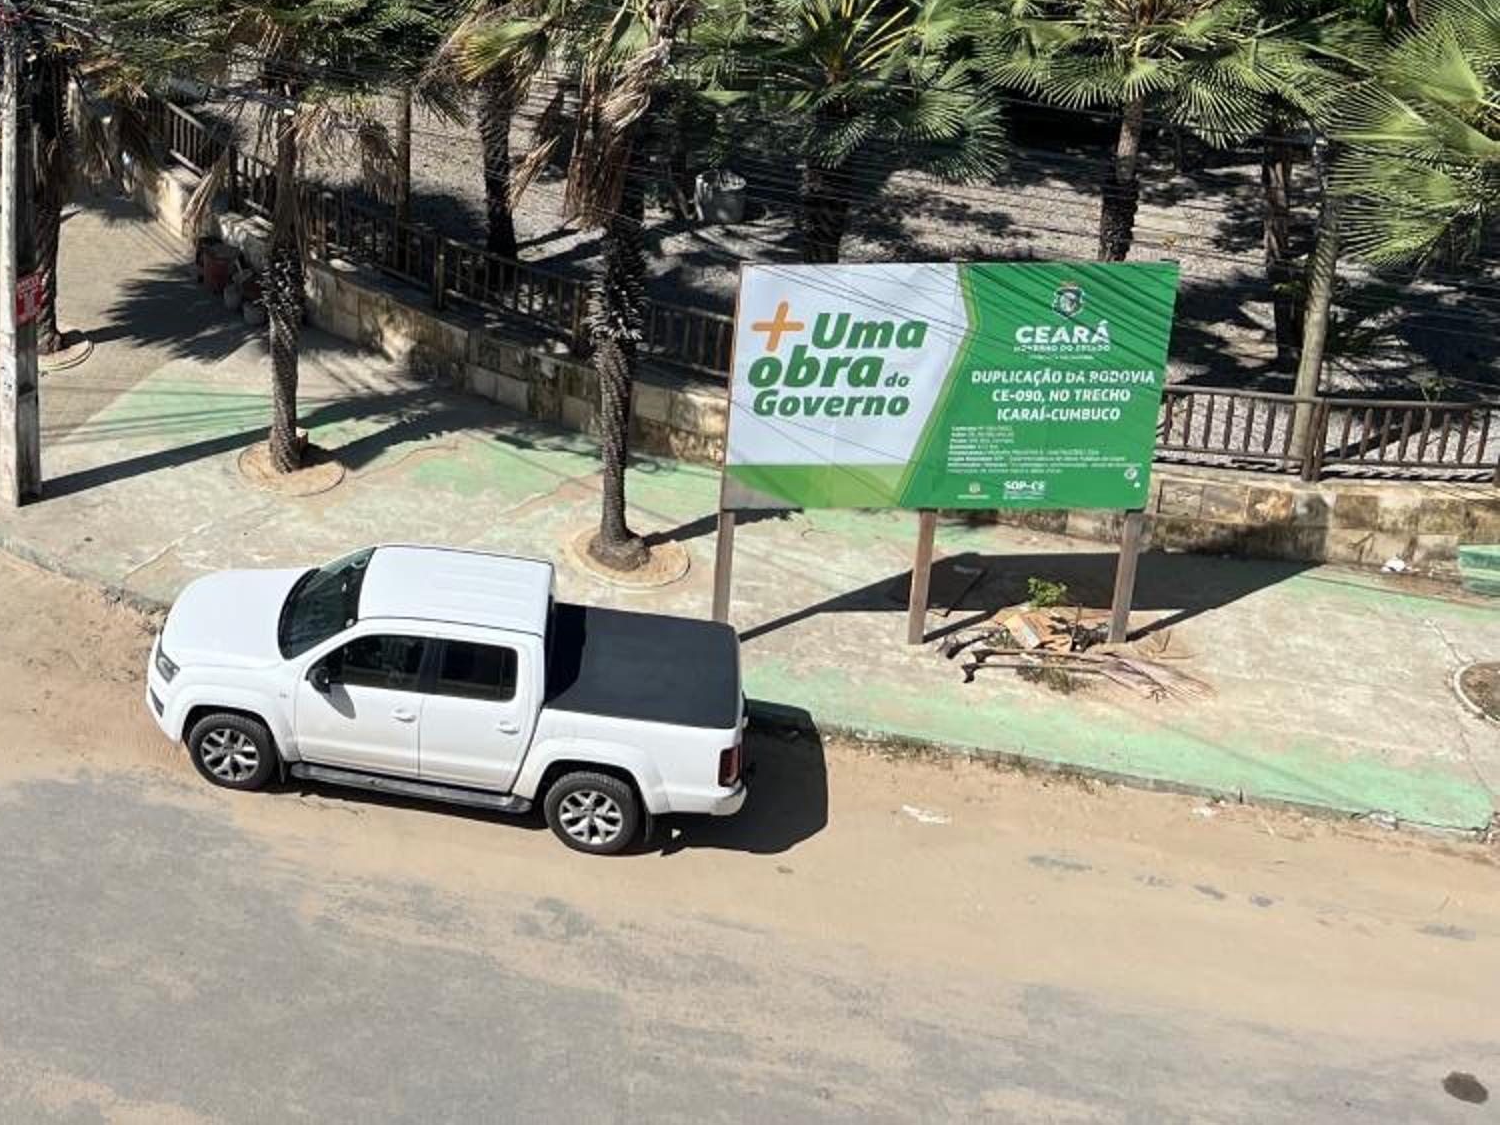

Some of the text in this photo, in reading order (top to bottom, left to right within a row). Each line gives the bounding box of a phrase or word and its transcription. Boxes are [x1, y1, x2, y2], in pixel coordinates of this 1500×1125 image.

[811, 312, 929, 350] Uma
[1014, 320, 1111, 344] CEARÁ
[747, 344, 910, 388] obra do
[971, 368, 1156, 387] DUPLICAÇÃO DA RODOVIA
[753, 388, 910, 417] Governo
[992, 388, 1131, 404] CE-090, NO TRECHO
[997, 407, 1121, 422] ICARAÍ-CUMBUCO
